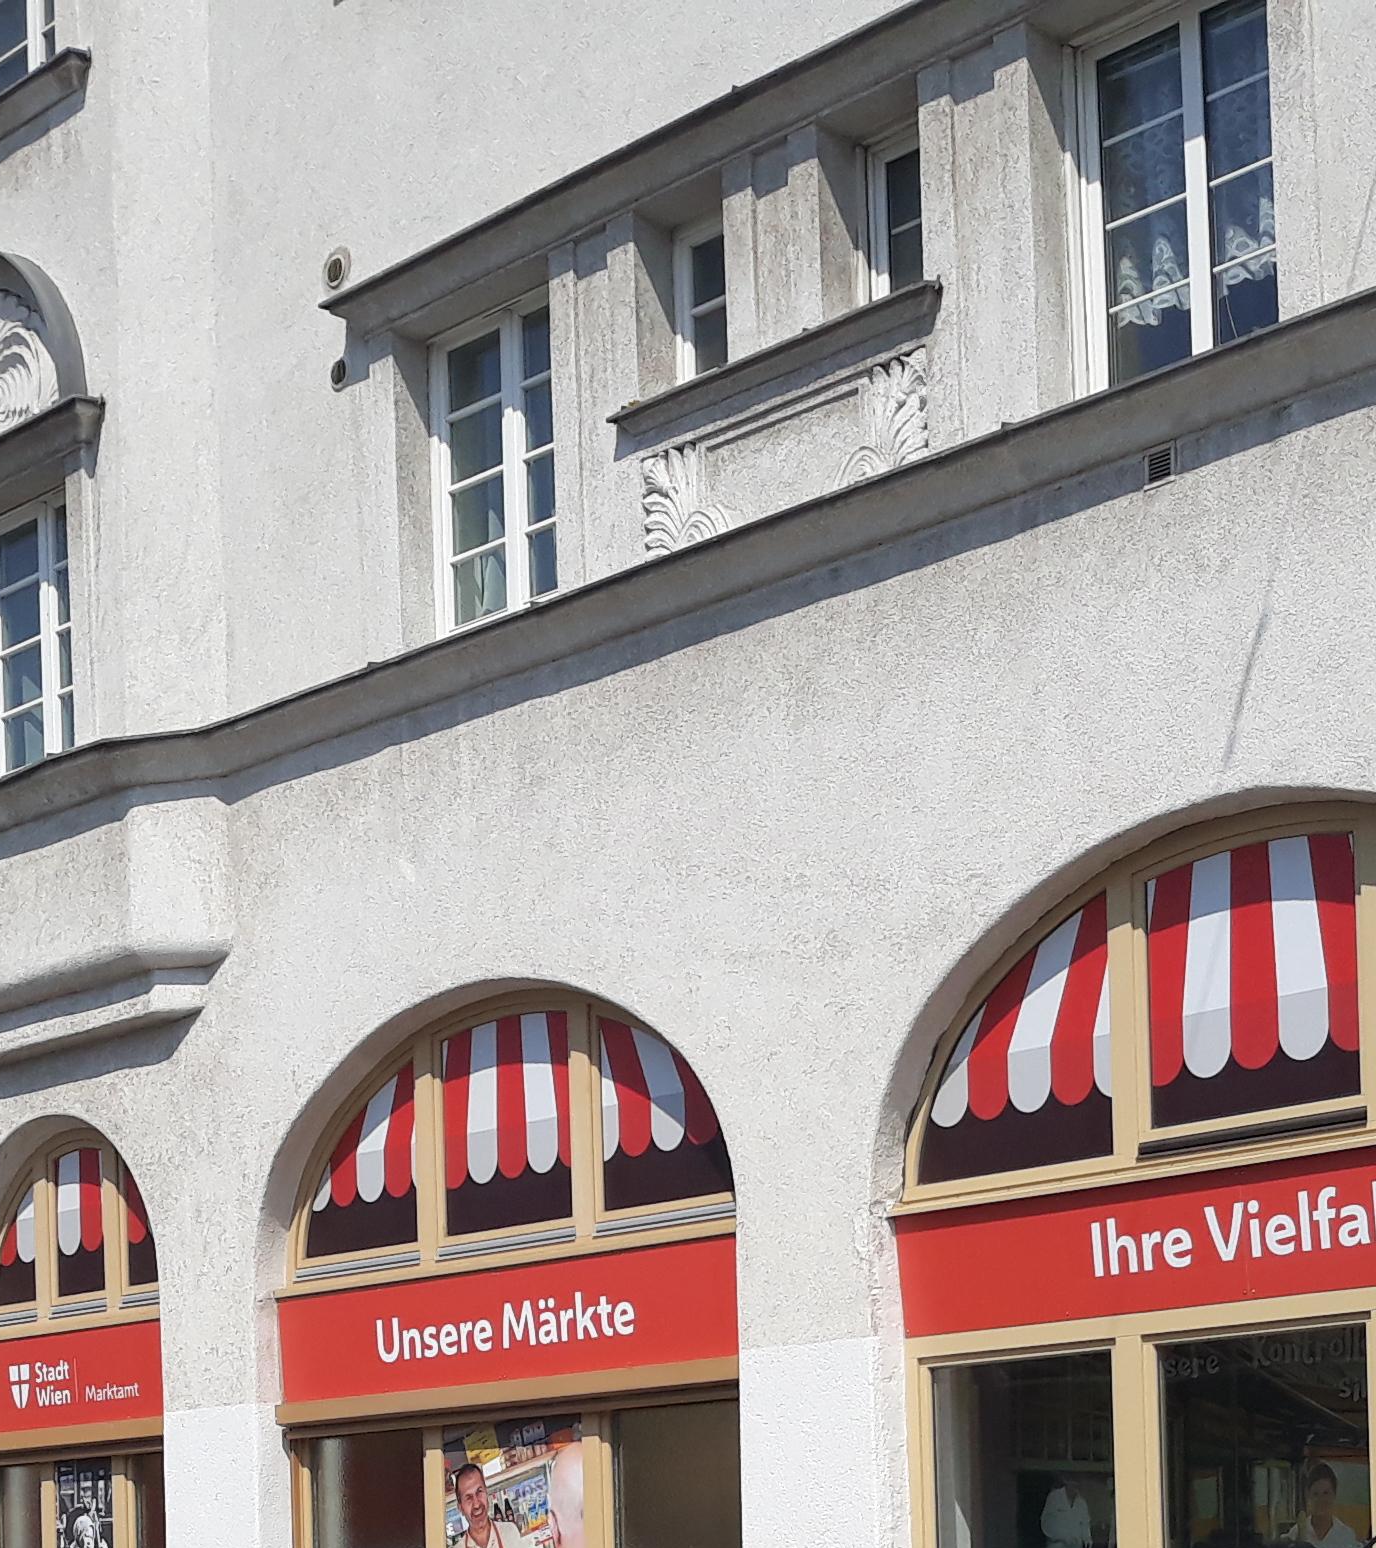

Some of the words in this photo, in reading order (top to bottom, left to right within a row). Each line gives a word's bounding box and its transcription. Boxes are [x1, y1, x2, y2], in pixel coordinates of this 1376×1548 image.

[1089, 1216, 1193, 1278] Ihre
[375, 1316, 493, 1364] Unsere
[502, 1291, 635, 1349] Märkte
[34, 1359, 70, 1384] Stadt
[1164, 1354, 1220, 1379] sere
[1251, 1326, 1363, 1370] Kontroll
[35, 1385, 71, 1408] Wien
[85, 1382, 140, 1403] Marktamt
